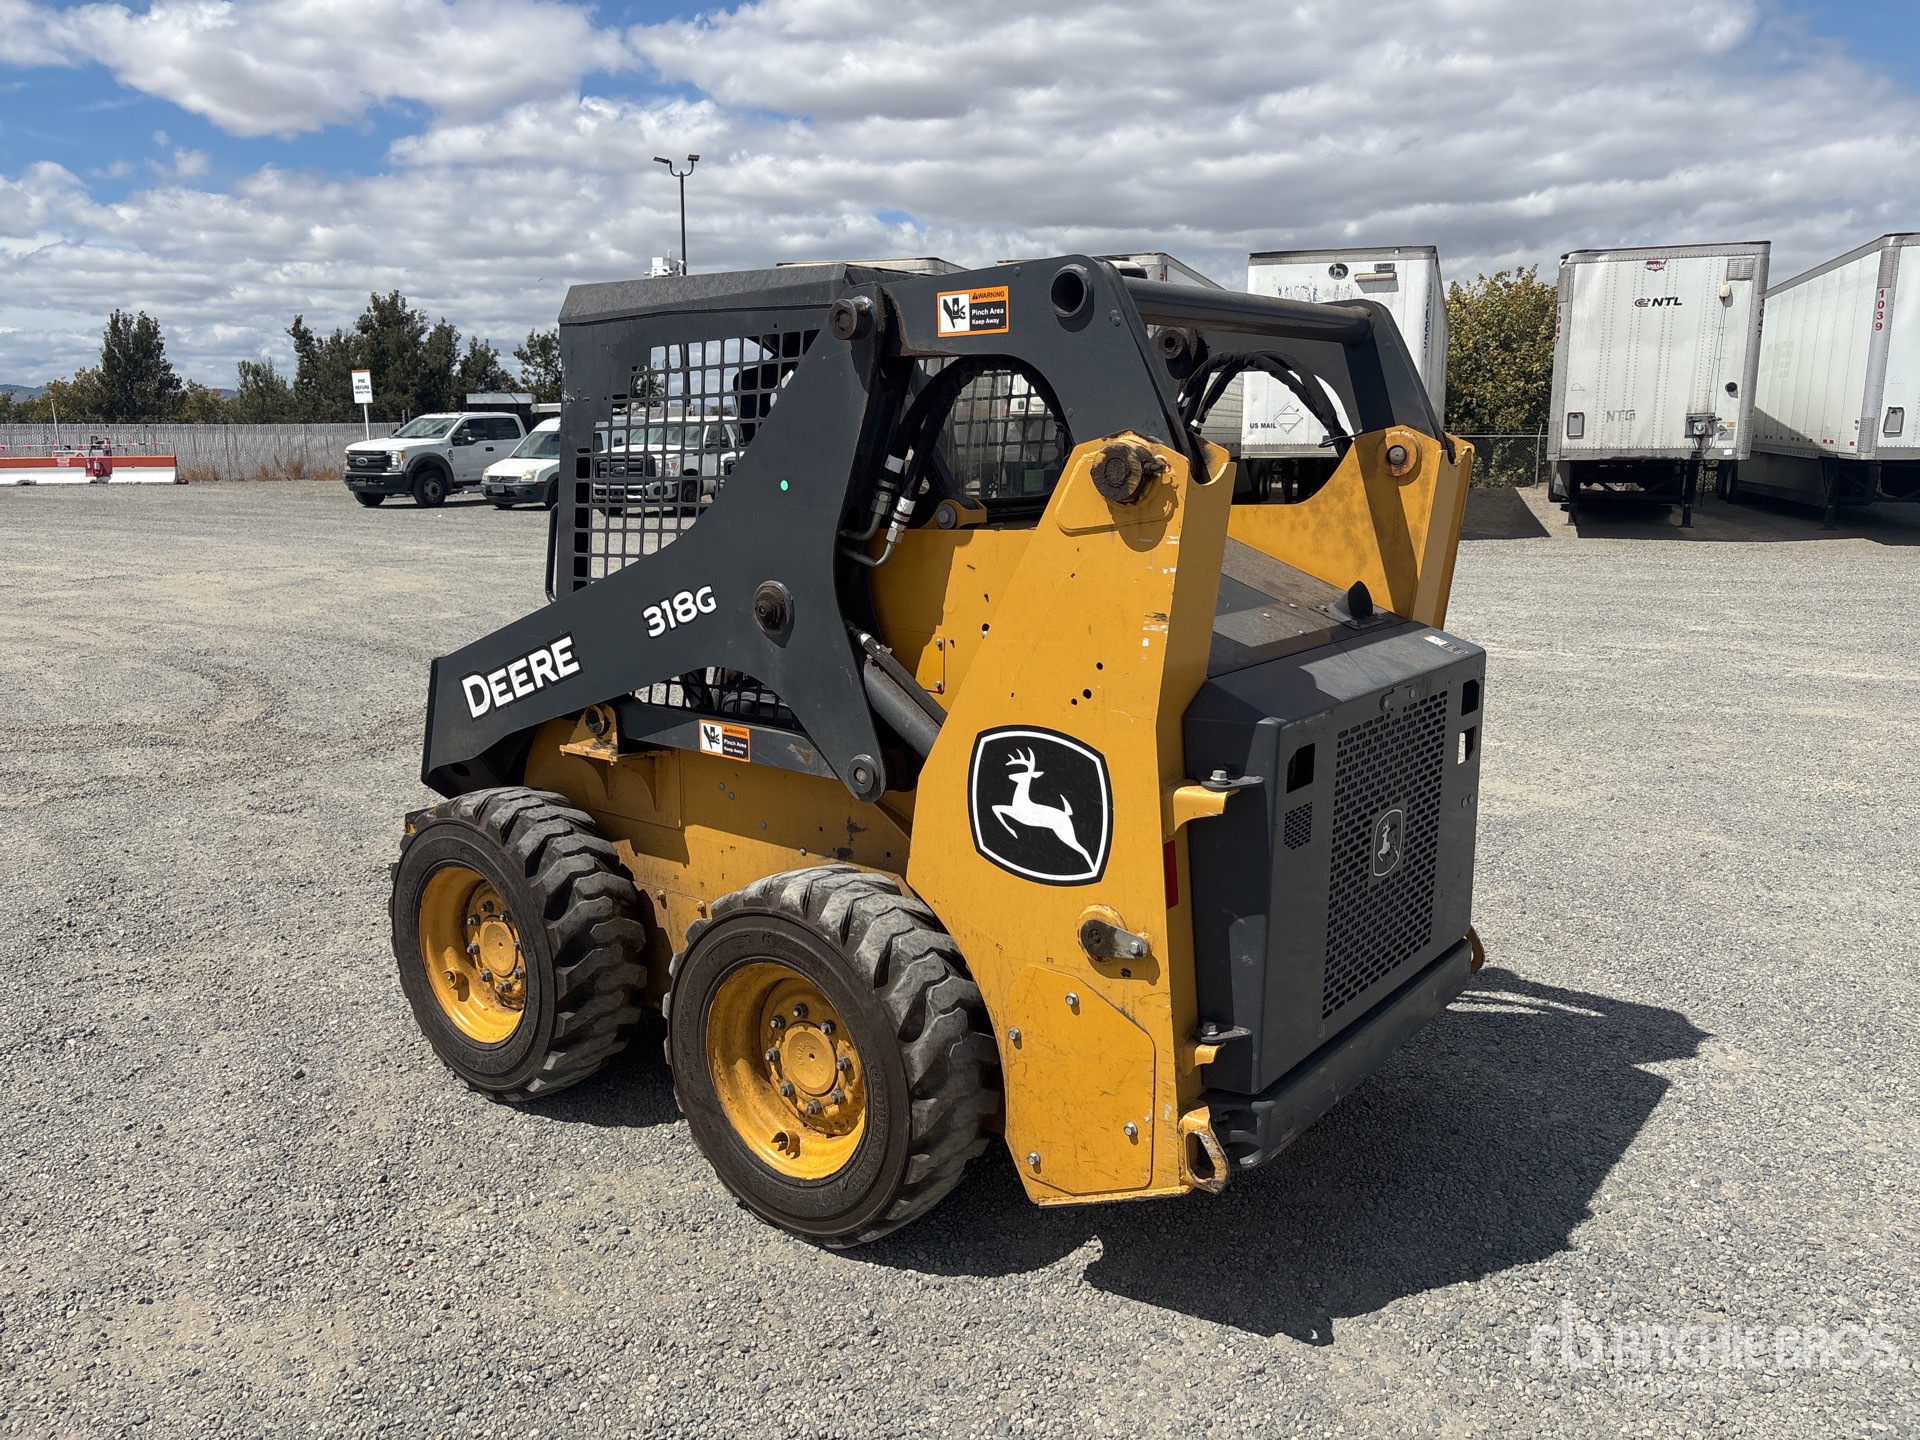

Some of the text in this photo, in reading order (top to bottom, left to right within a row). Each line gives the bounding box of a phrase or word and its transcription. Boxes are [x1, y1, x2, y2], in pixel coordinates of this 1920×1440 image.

[978, 290, 1004, 299] WARNING
[1651, 296, 1683, 307] NTL
[1875, 289, 1885, 331] 1039
[642, 585, 718, 638] 318G
[461, 636, 581, 719] DEERE
